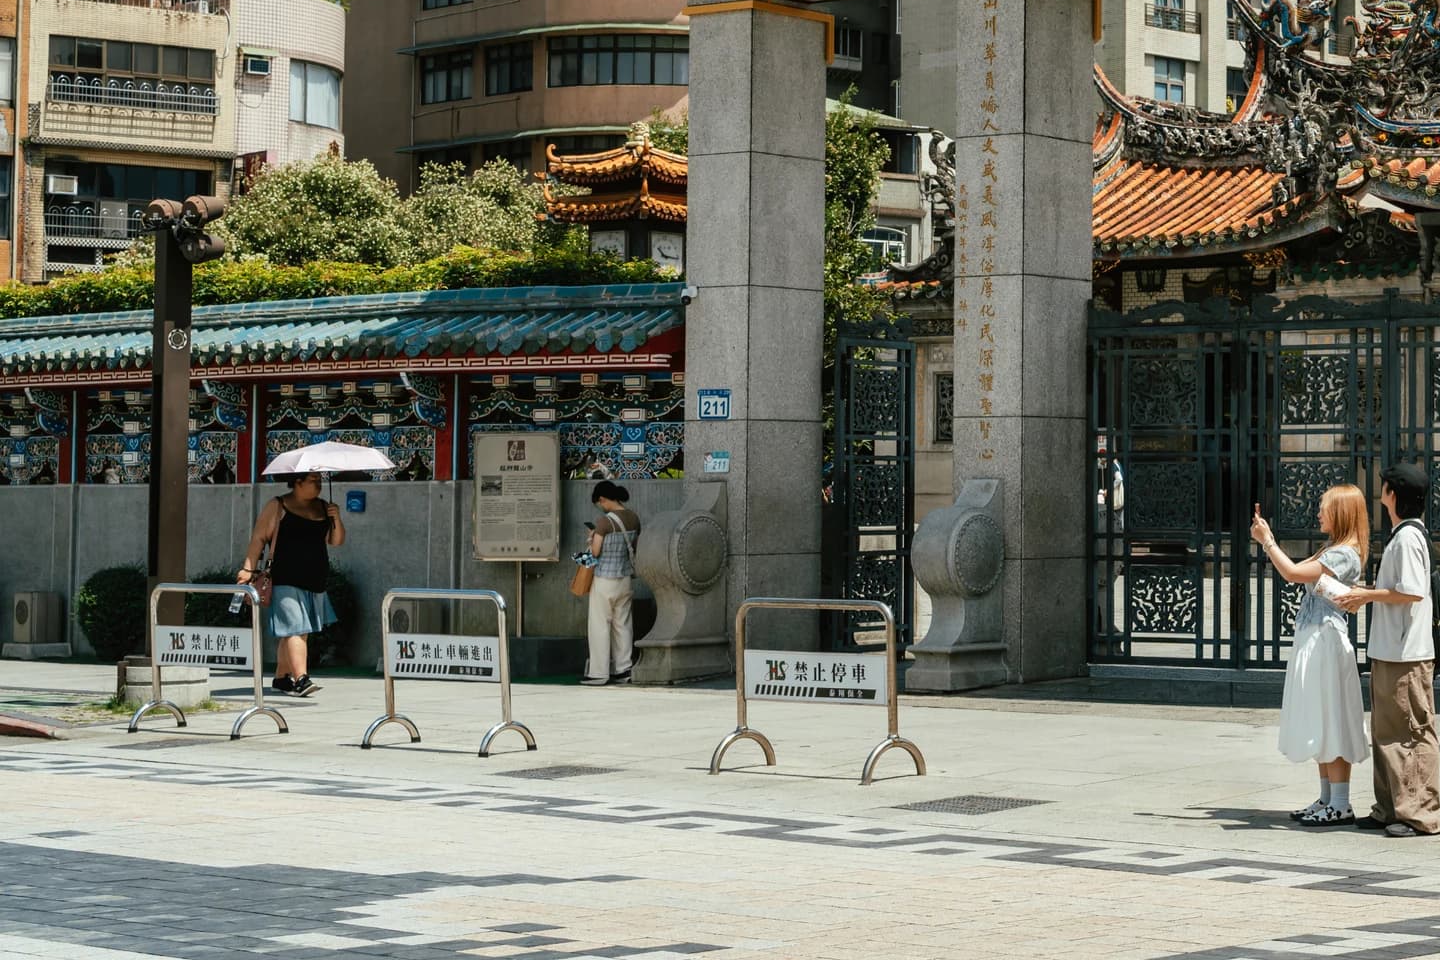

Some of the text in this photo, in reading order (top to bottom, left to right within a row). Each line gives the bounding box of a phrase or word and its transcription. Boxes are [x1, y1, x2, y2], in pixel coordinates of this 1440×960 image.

[703, 400, 726, 416] 211
[712, 460, 727, 471] 211
[191, 632, 241, 653] 禁止停車
[421, 641, 493, 662] 禁止車輛進出
[794, 660, 867, 684] 禁止停車
